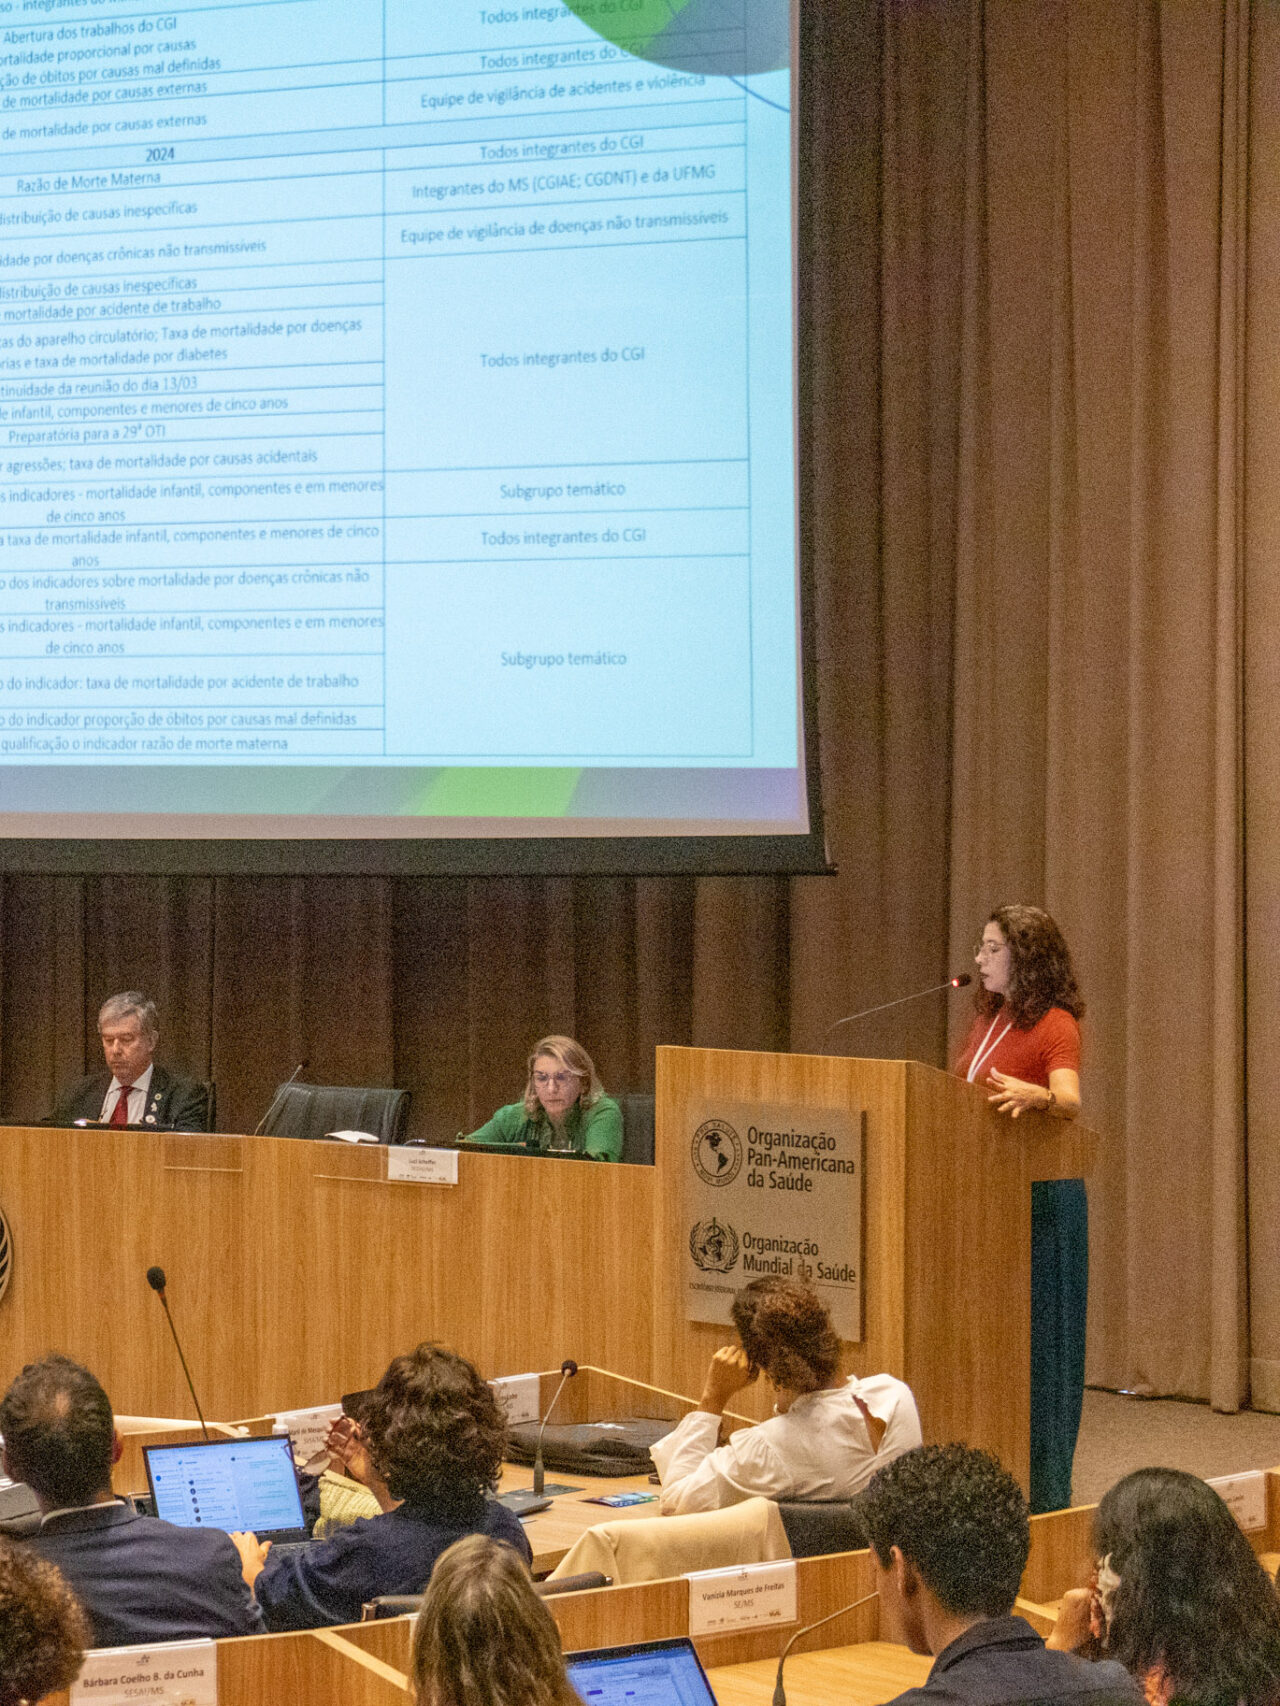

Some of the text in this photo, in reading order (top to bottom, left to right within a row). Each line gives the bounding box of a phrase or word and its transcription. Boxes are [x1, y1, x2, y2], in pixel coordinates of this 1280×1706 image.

[2, 17, 178, 45] Abertura dos trabalhos do CGI
[56, 43, 132, 64] proporcional
[132, 45, 154, 58] por
[156, 41, 197, 52] causas
[419, 93, 465, 110] Equipe
[467, 91, 485, 104] de
[486, 86, 546, 105] vigilância
[548, 84, 566, 98] de
[568, 81, 632, 96] acidentes
[1, 128, 17, 140] de
[18, 122, 89, 139] mortalidade
[90, 124, 112, 136] por
[114, 120, 154, 131] causas
[155, 116, 208, 128] externas
[145, 148, 176, 161] 2024
[480, 135, 645, 160] Todos integrantes do CGI
[410, 183, 485, 200] Integrantes
[486, 180, 506, 193] do
[507, 178, 530, 192] MS
[583, 170, 638, 187] CGDNT)
[652, 169, 670, 182] da
[672, 165, 716, 181] UFMG
[399, 229, 444, 246] Equipe
[446, 227, 464, 240] de
[465, 223, 526, 241] vigilância
[528, 222, 546, 235] de
[547, 221, 603, 234] doenças
[605, 216, 632, 230] não
[32, 256, 53, 268] por
[55, 251, 104, 264] doenças
[105, 246, 155, 260] crônicas
[157, 244, 181, 257] não
[58, 382, 72, 395] da
[75, 380, 120, 394] reunião
[122, 379, 138, 392] do
[141, 378, 159, 391] dia
[164, 376, 198, 390] 13/03
[499, 482, 627, 501] Subgrupo temático
[481, 528, 647, 547] Todos integrantes do CGI
[500, 652, 628, 669] Subgrupo temático
[1, 738, 70, 753] qualificação
[82, 738, 137, 750] indicador
[141, 738, 174, 750] razão
[176, 738, 192, 750] de
[194, 739, 233, 750] morte
[235, 739, 289, 750] materna
[748, 1126, 836, 1155] Organização
[748, 1149, 854, 1174] Pan-Americana
[748, 1169, 764, 1188] da
[769, 1172, 812, 1192] Saúde
[743, 1233, 818, 1259] Organização
[743, 1255, 856, 1283] Mundial da Saúde
[726, 1588, 754, 1598] Marques
[764, 1583, 784, 1591] Freitas
[84, 1678, 118, 1688] Bárbara
[120, 1675, 150, 1684] Coelho
[164, 1672, 174, 1680] da
[177, 1669, 204, 1679] Cunha
